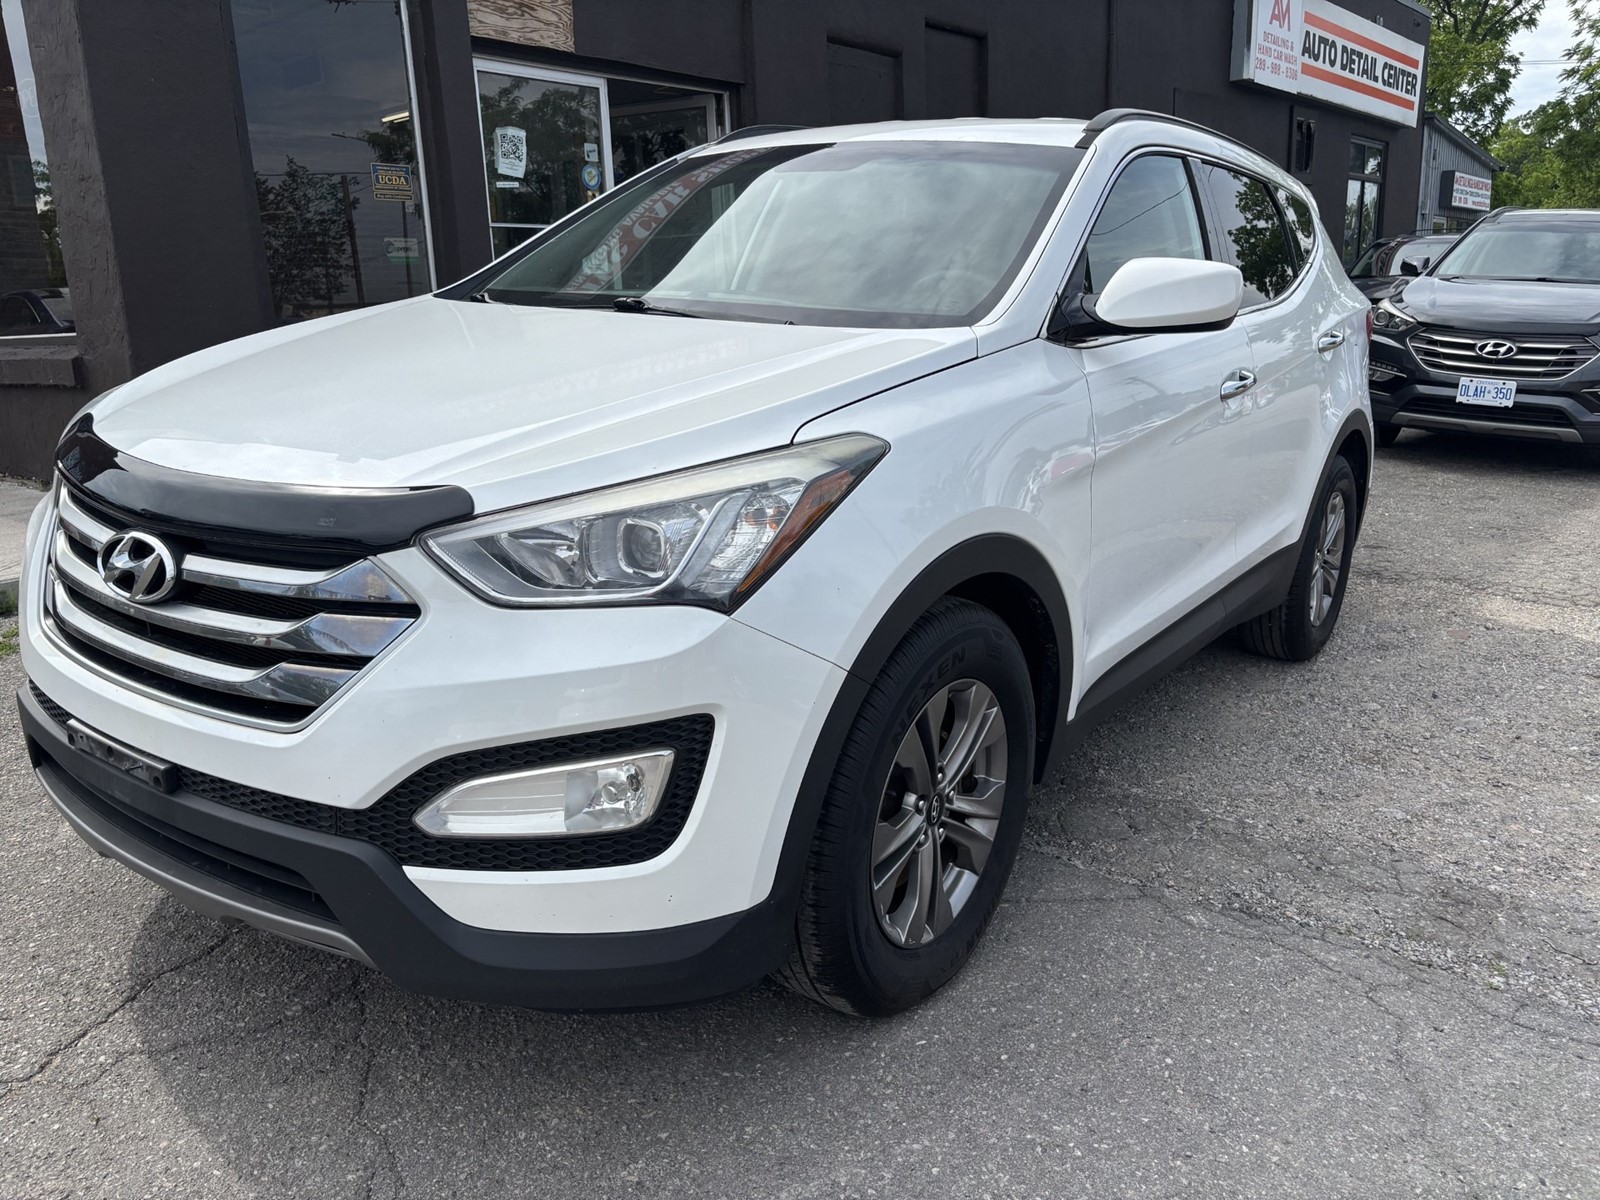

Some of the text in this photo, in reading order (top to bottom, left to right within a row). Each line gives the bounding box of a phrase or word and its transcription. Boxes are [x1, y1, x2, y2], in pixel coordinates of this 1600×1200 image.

[1263, 31, 1289, 50] DETAILING
[1257, 43, 1298, 66] HAND CAR WASH
[1301, 30, 1418, 97] AUTO DETAIL CENTER
[378, 175, 407, 185] UCDA
[1492, 387, 1513, 400] 350
[892, 646, 967, 747] NEXEN
